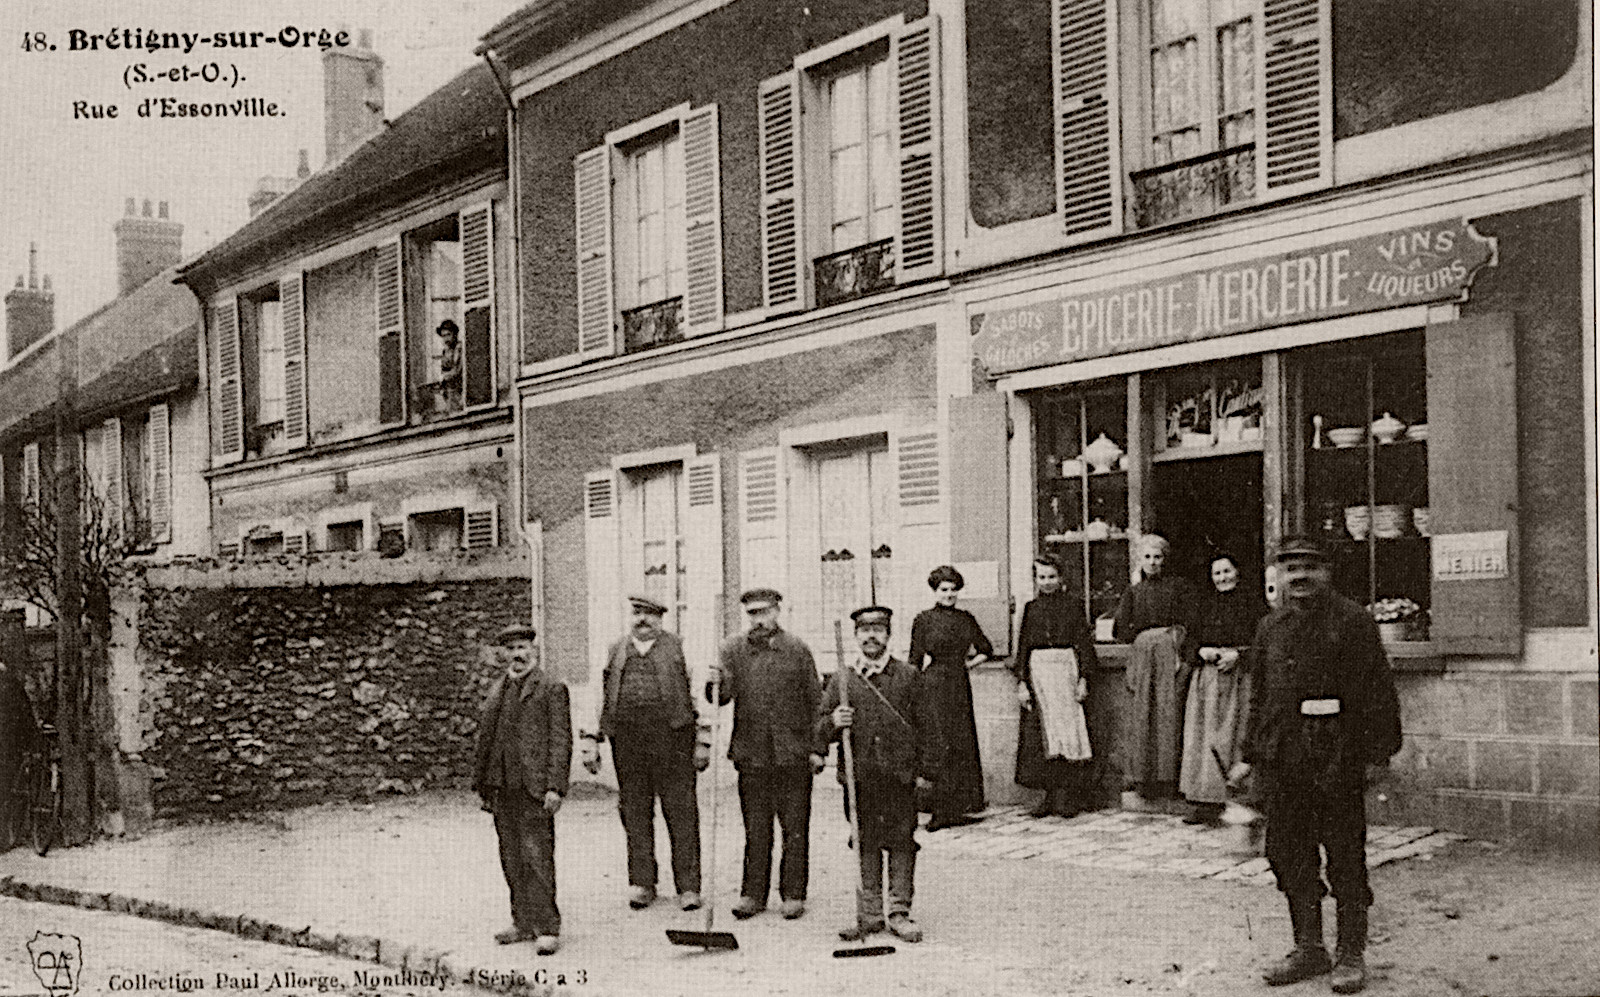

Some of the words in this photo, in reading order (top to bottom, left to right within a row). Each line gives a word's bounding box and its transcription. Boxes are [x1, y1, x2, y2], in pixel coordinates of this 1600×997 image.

[1377, 229, 1456, 261] VINS
[1367, 259, 1467, 301] LIQUEURS
[989, 310, 1045, 338] SABOTS
[985, 334, 1051, 368] GALOCHES
